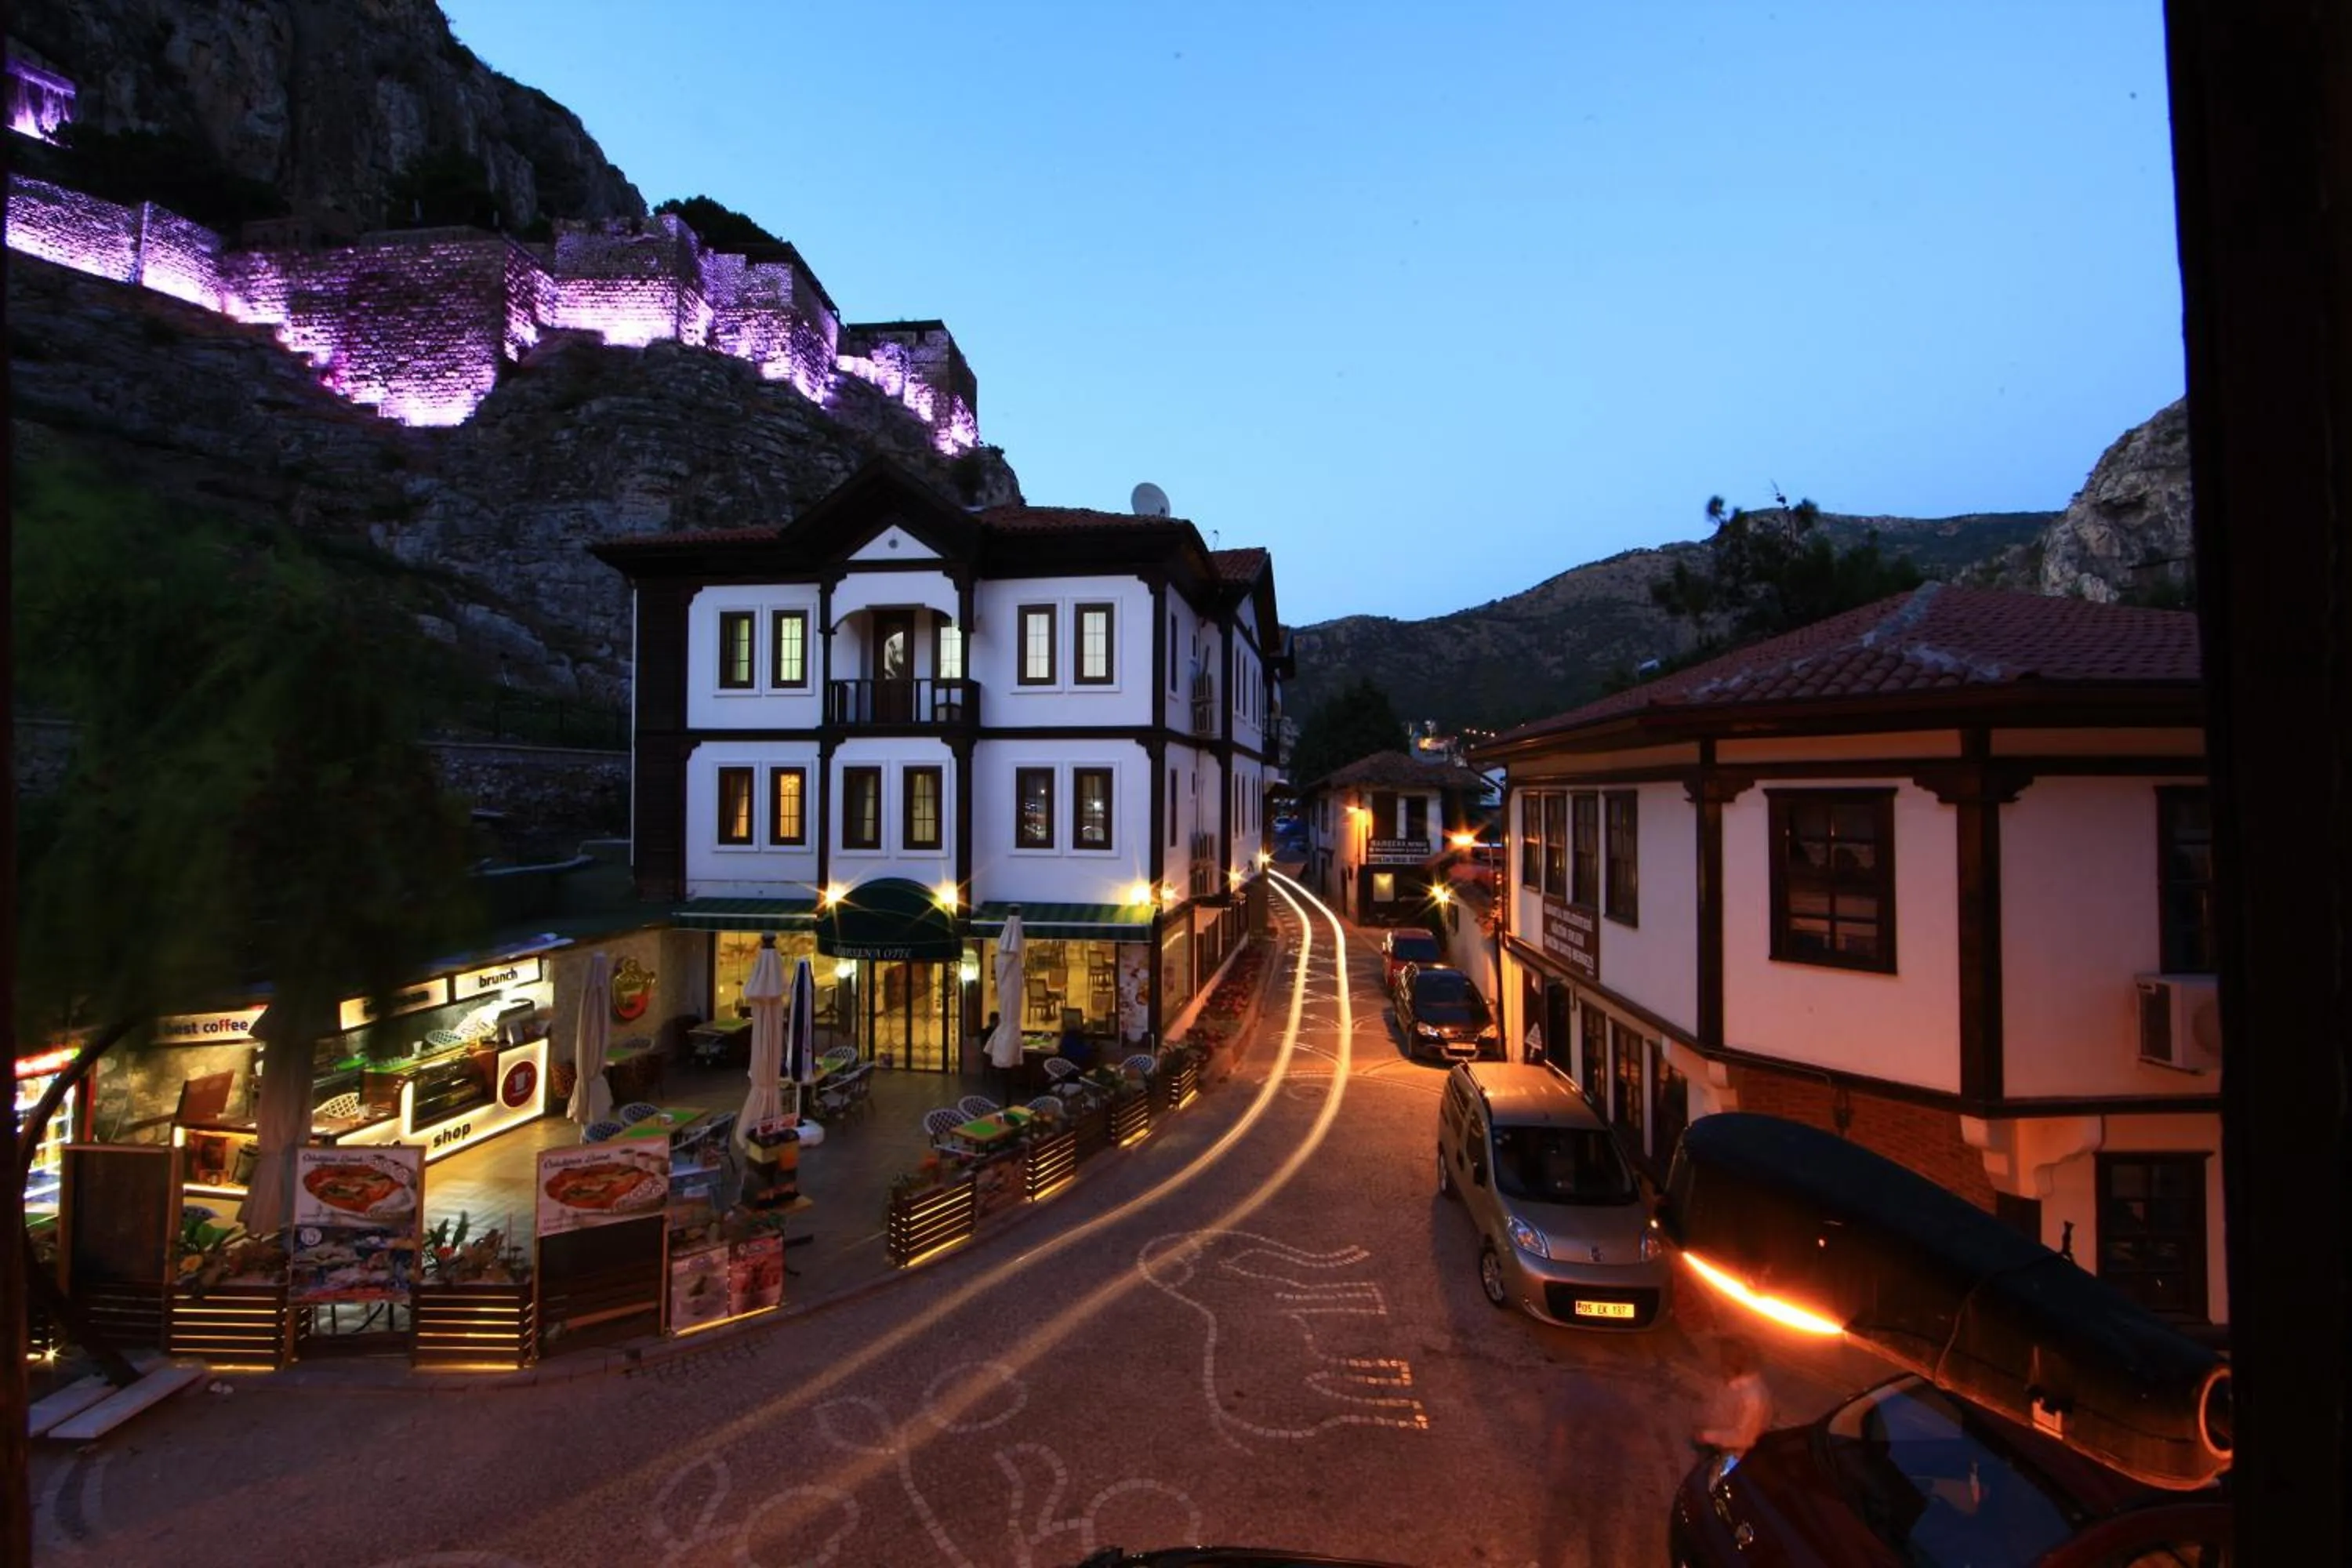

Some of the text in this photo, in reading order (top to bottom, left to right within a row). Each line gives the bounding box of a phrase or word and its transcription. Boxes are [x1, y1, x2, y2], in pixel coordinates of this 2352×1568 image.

[478, 967, 518, 988] brunch
[203, 1018, 249, 1034] coffee
[433, 1122, 471, 1149] shop
